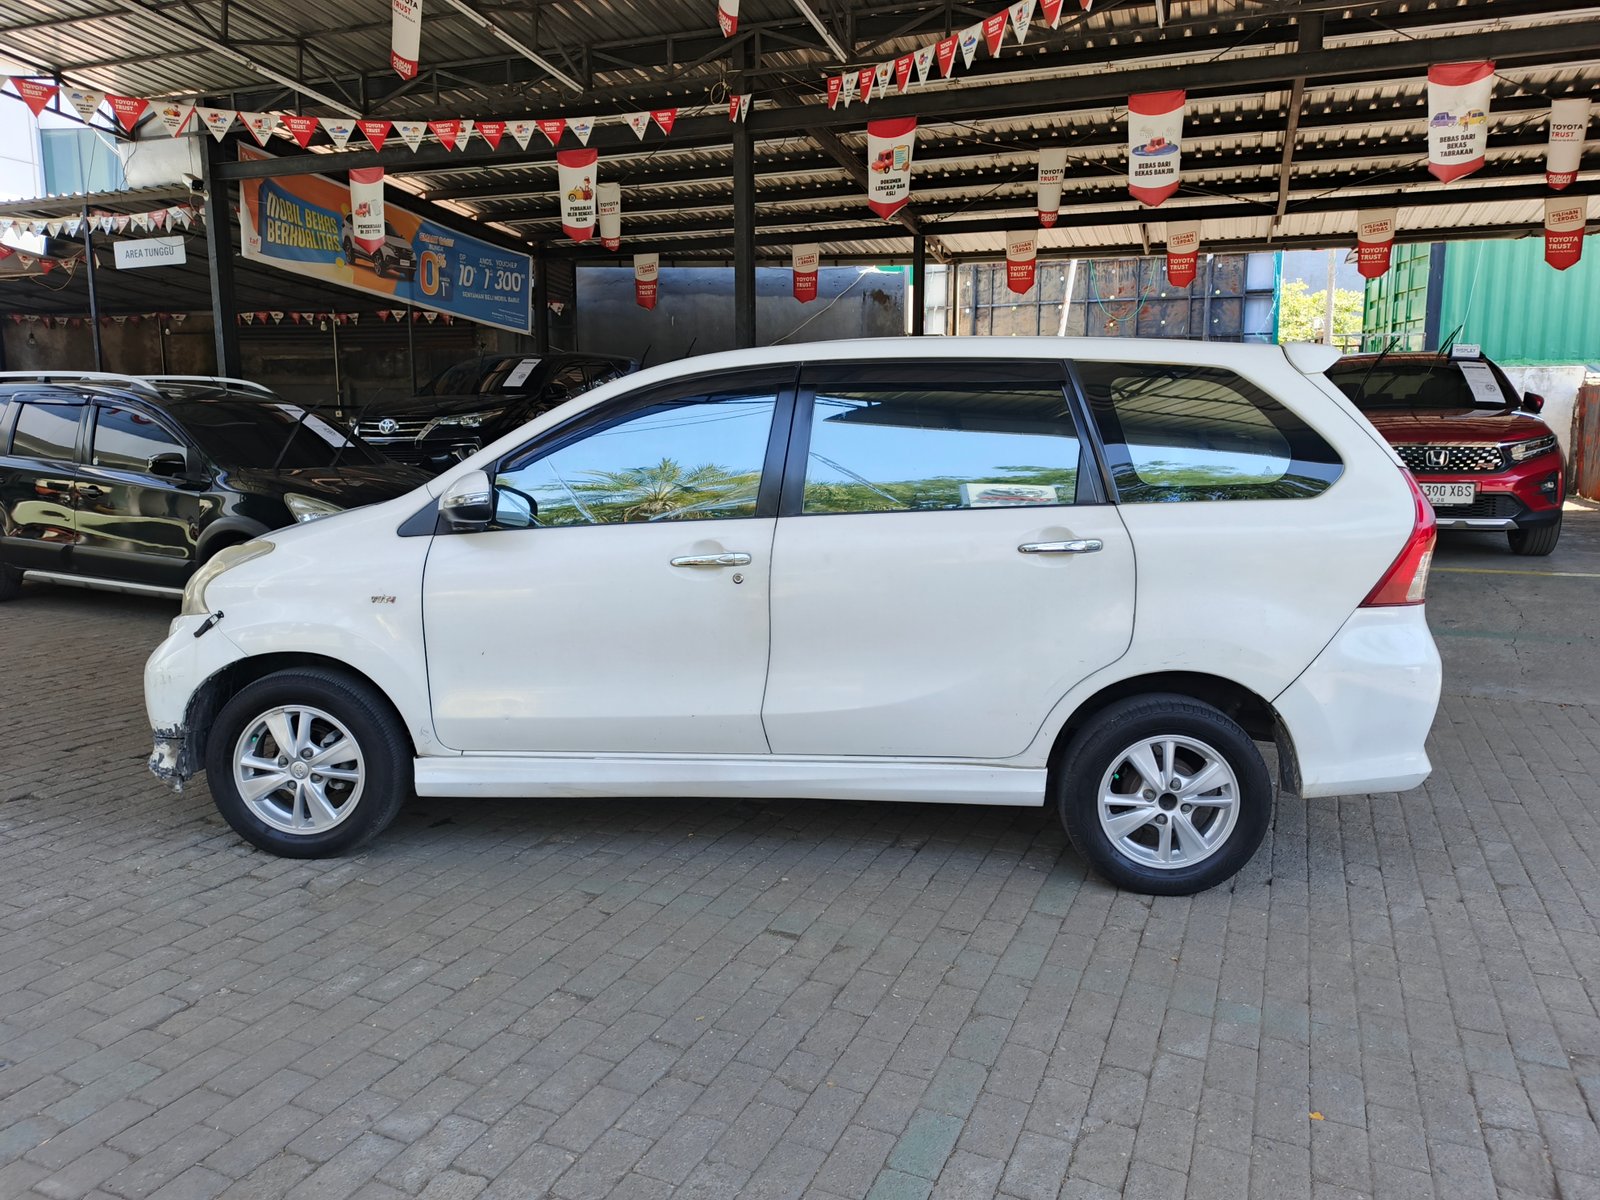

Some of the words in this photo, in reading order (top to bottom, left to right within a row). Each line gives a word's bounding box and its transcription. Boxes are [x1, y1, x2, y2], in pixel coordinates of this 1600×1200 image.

[22, 83, 48, 92] TOYOTA
[115, 98, 138, 107] TOYOTA
[1439, 136, 1459, 144] BEBAS
[1446, 142, 1467, 150] BEKAS
[1440, 148, 1473, 157] TABRAKAN
[267, 191, 303, 226] MOBIL
[304, 208, 338, 234] BEKAS
[267, 218, 341, 252] BERKUALITAS
[125, 248, 143, 259] AREA
[144, 246, 175, 257] TUNGGU
[1449, 485, 1472, 497] XBS
